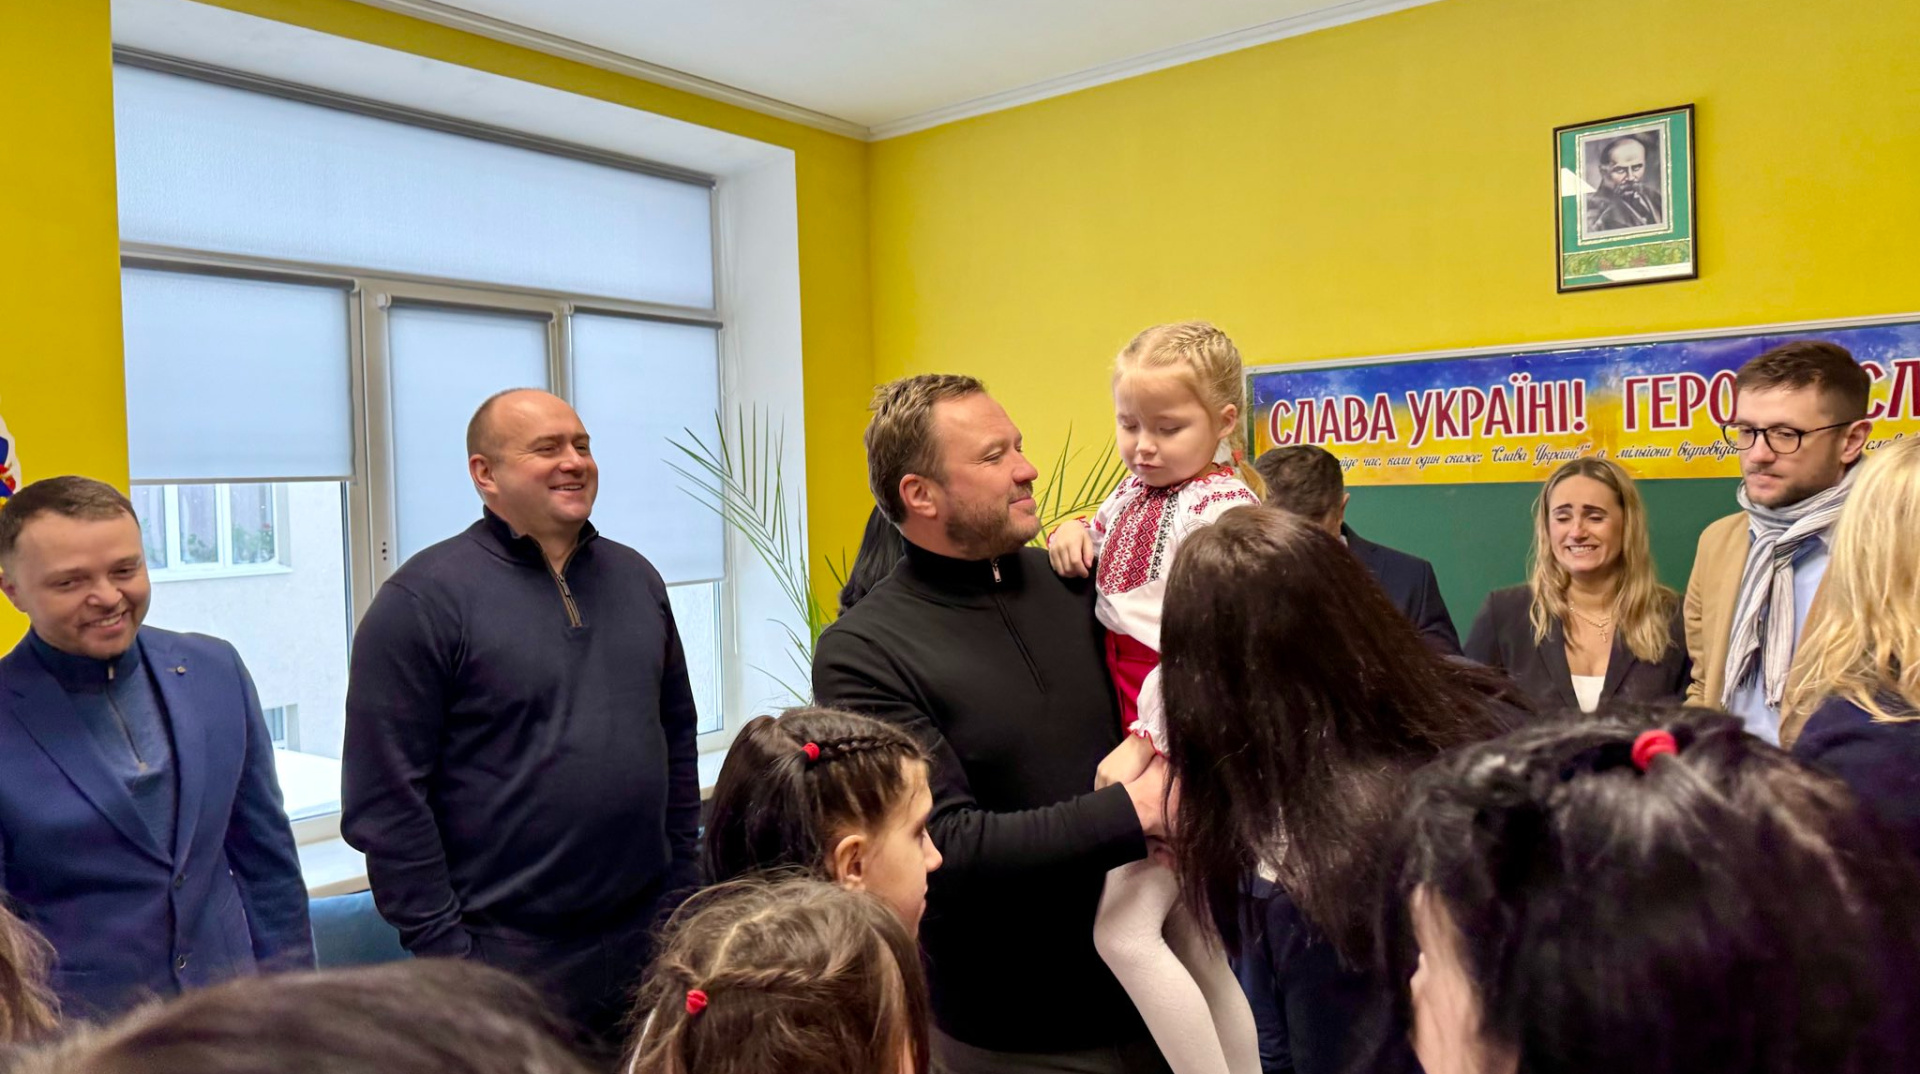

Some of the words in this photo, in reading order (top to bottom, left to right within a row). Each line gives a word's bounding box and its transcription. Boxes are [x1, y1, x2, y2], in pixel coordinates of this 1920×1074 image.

[1271, 394, 1396, 446] СЛАВА
[1408, 374, 1586, 447] УКРАЇНІ!
[1625, 370, 1738, 430] ГЕРО
[1387, 456, 1412, 466] коли
[1416, 454, 1441, 469] один
[1444, 453, 1483, 464] скаже:
[1616, 445, 1672, 458] мільйони
[1677, 440, 1739, 461] відповіда
